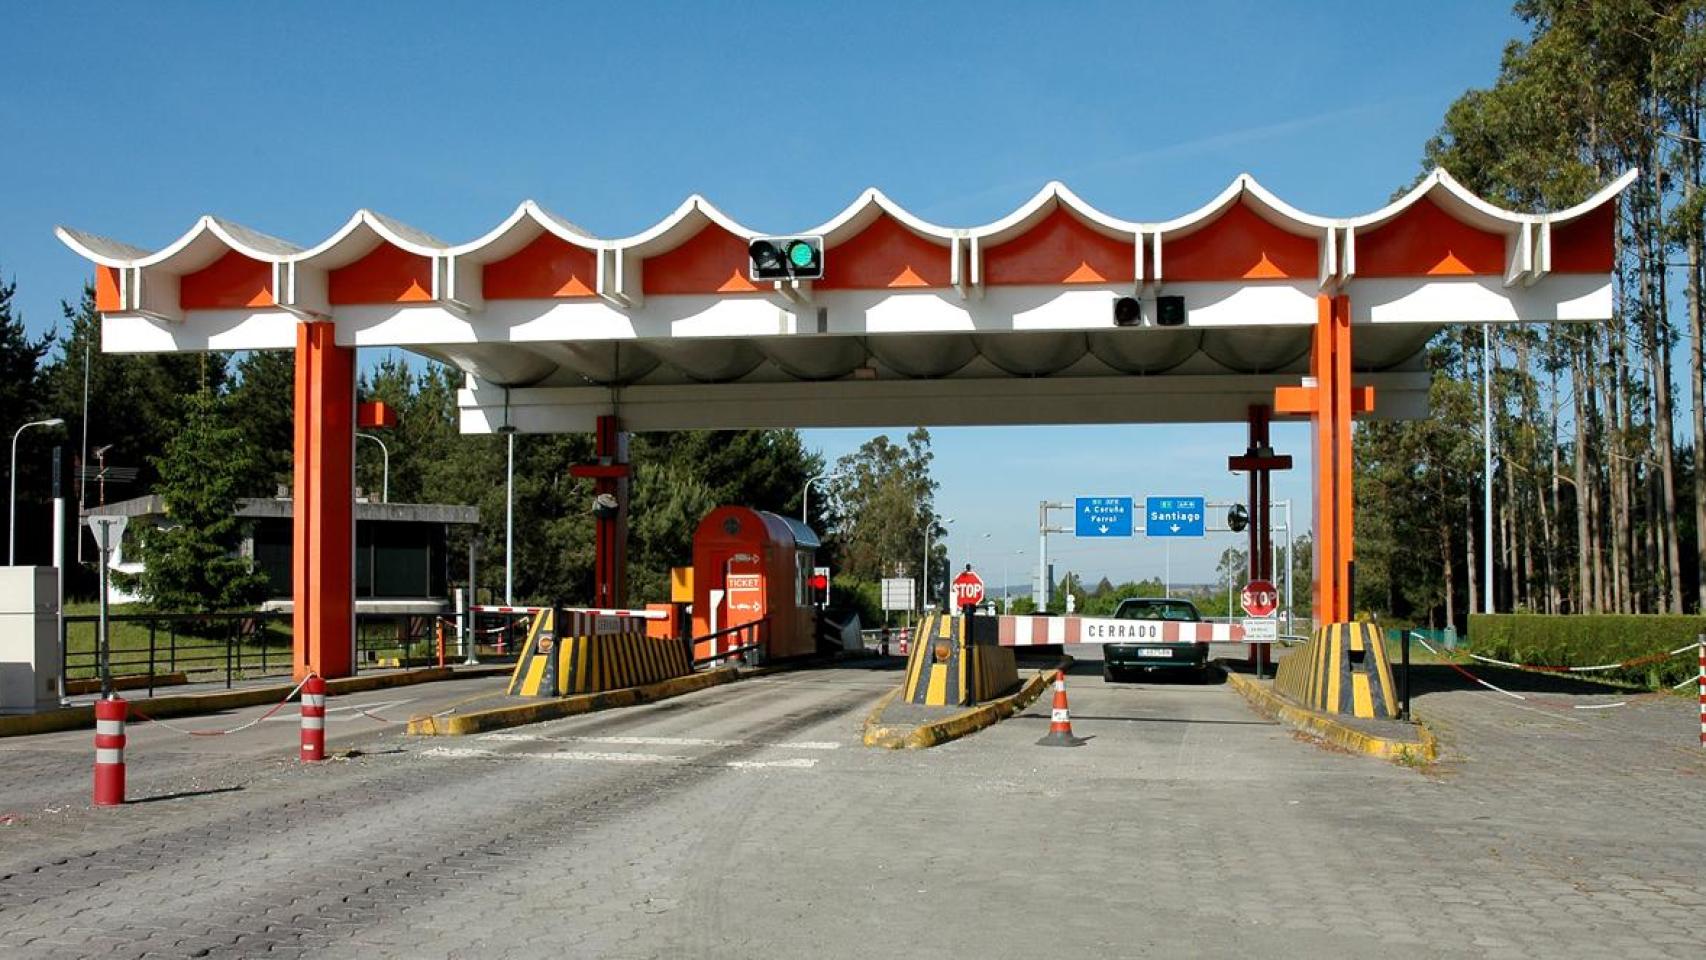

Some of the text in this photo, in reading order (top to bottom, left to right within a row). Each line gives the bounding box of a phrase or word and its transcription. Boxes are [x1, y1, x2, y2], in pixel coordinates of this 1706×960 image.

[1094, 505, 1125, 513] Coruña
[1151, 511, 1200, 524] Santiago
[728, 578, 760, 588] TICKET
[953, 583, 981, 599] STOP
[1243, 591, 1277, 606] STOP
[1088, 625, 1157, 638] CERRADO
